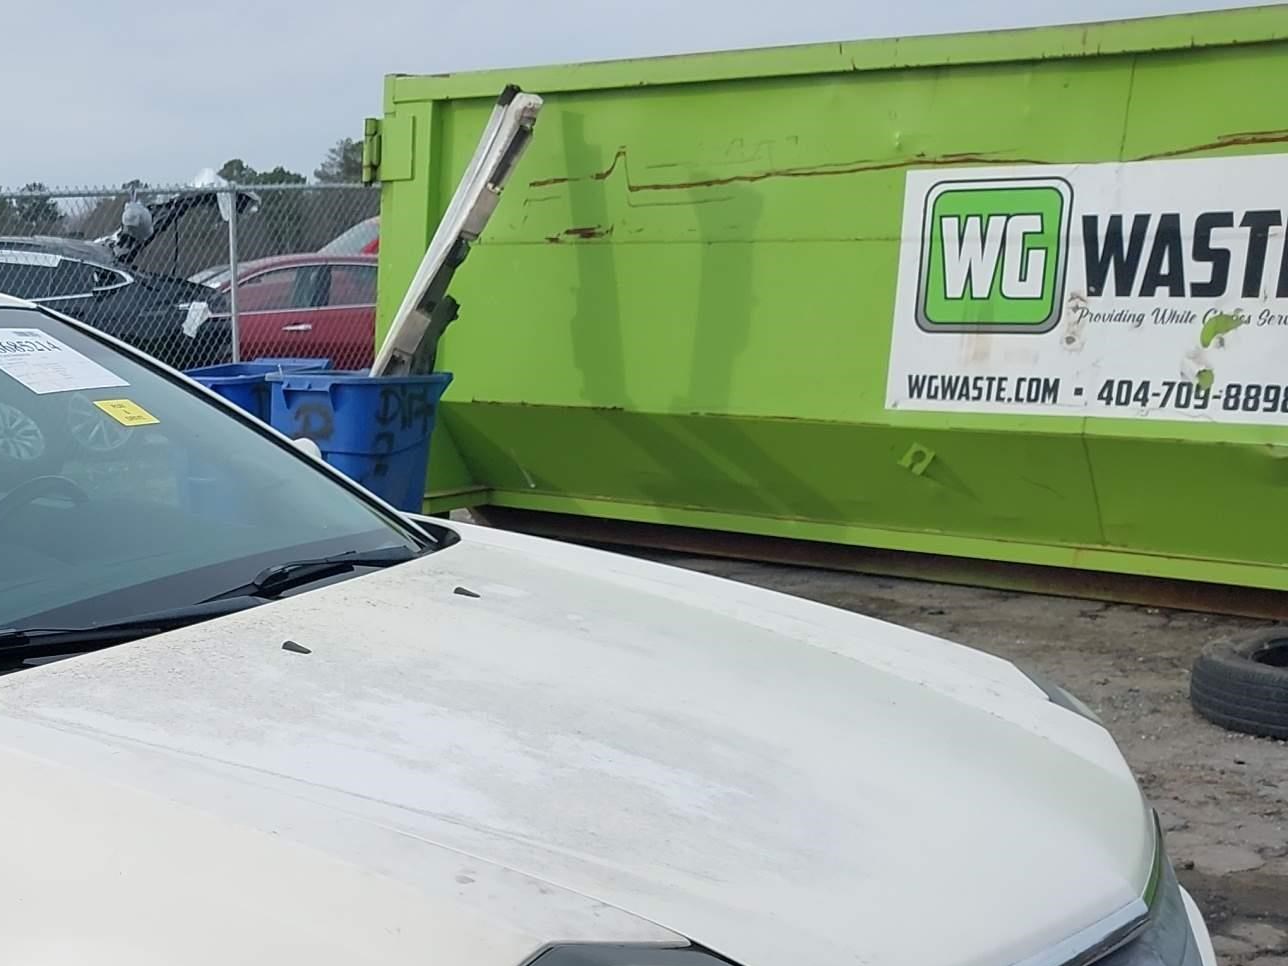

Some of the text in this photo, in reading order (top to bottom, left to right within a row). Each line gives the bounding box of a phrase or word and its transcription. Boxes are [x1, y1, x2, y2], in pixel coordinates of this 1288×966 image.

[940, 212, 1048, 300] WG
[1077, 307, 1146, 328] Providing
[1152, 308, 1197, 325] While
[908, 374, 1060, 404] WGWASTE.COM
